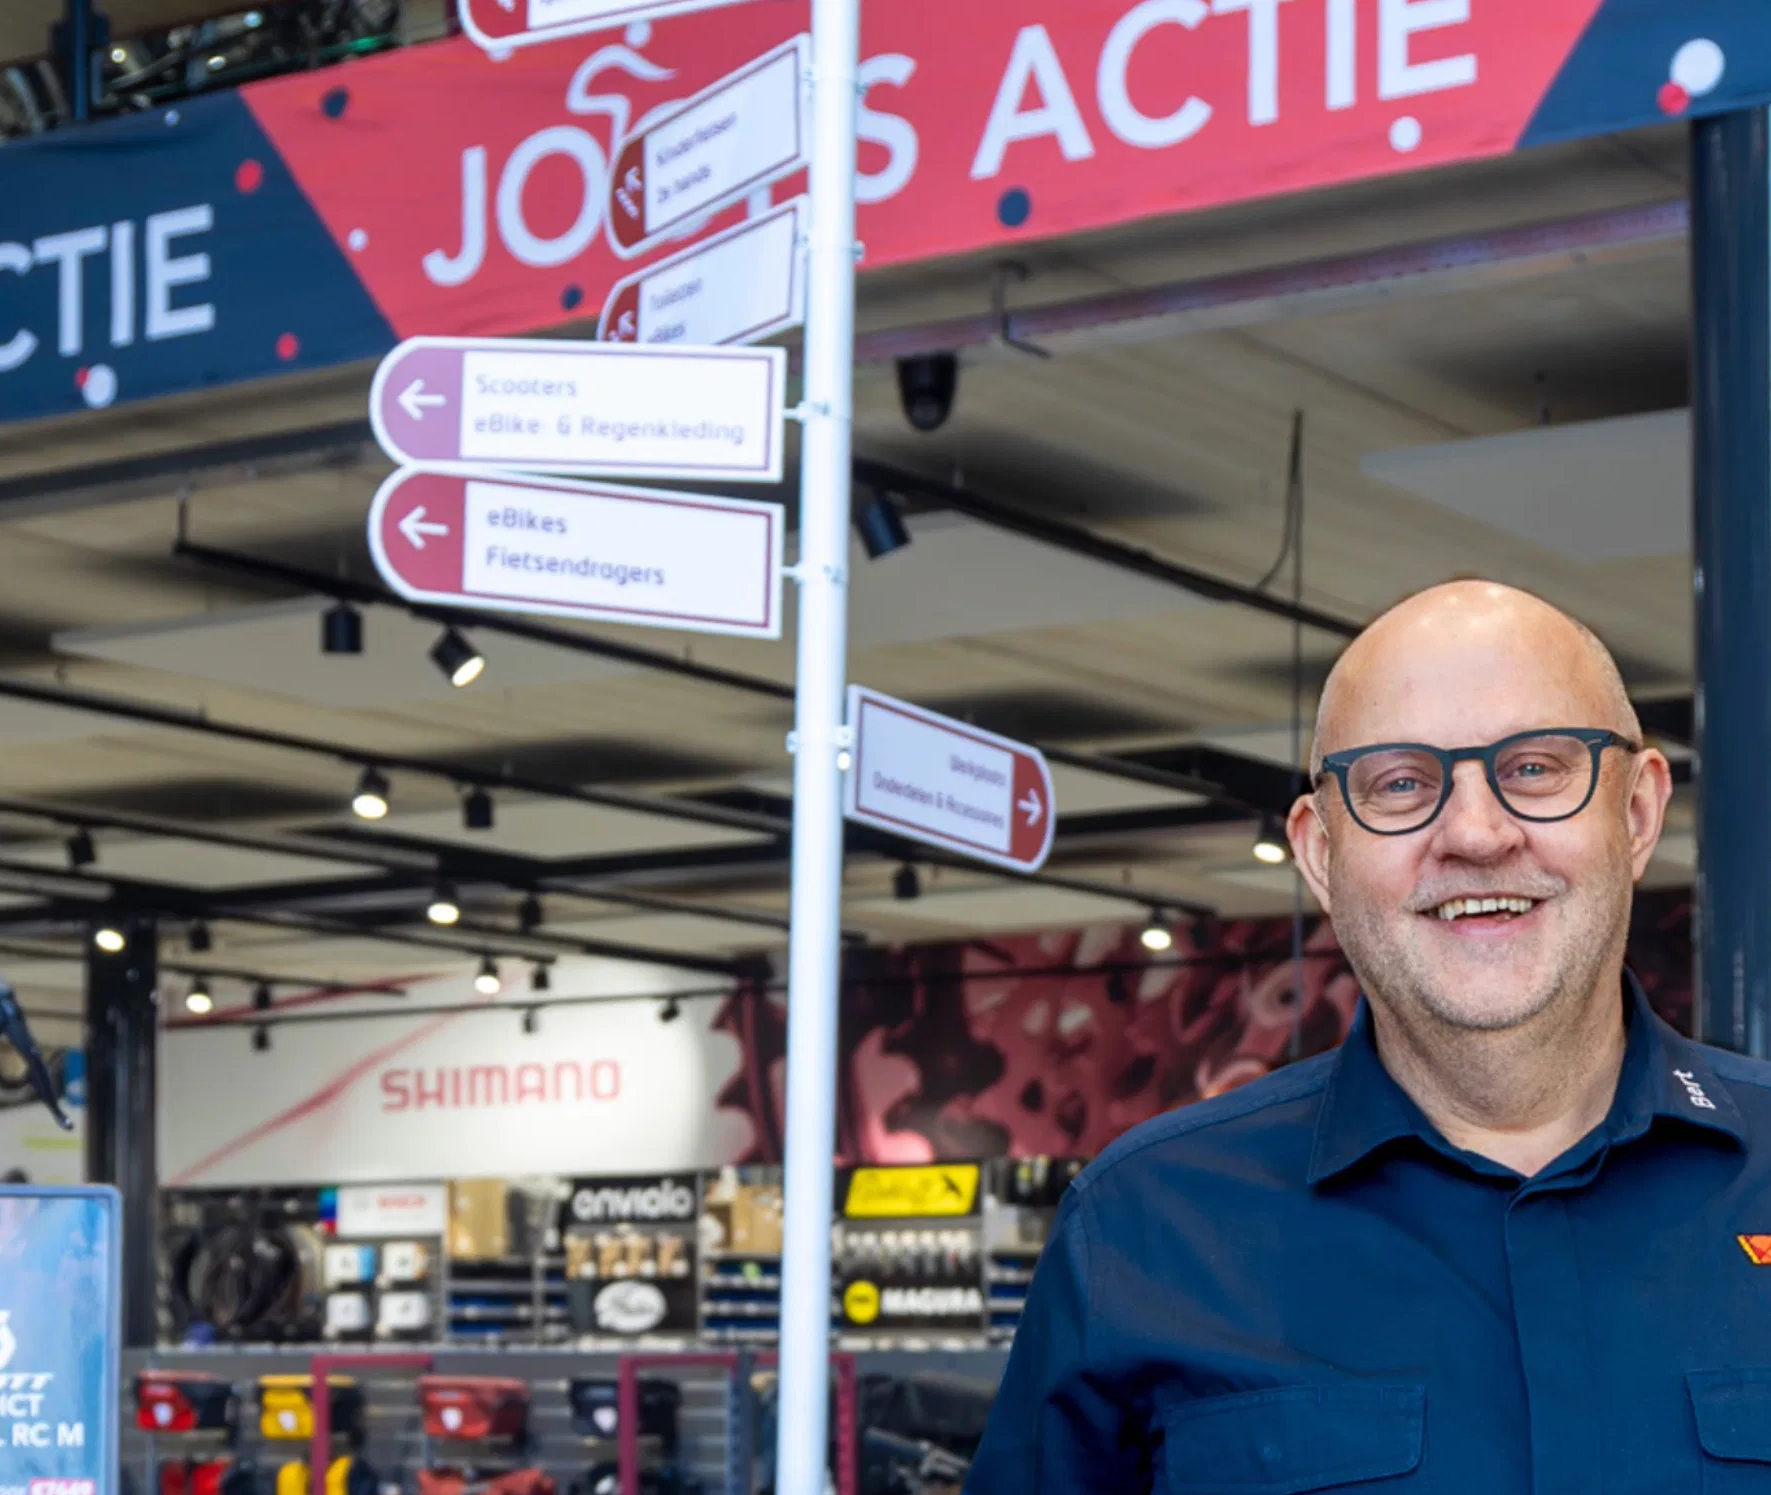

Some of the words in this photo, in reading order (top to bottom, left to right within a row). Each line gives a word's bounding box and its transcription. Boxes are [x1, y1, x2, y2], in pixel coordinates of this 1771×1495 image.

[422, 50, 918, 287] JOS
[969, 0, 1477, 181] ACTIE
[475, 372, 578, 397] Scooters
[579, 414, 746, 446] Regenkleding
[486, 506, 568, 535] eBikes
[485, 544, 667, 587] Fietsendragers
[379, 1058, 623, 1114] SHIMANO
[1672, 1068, 1717, 1110] Bert
[11, 1422, 50, 1447] RC
[56, 1422, 85, 1447] M
